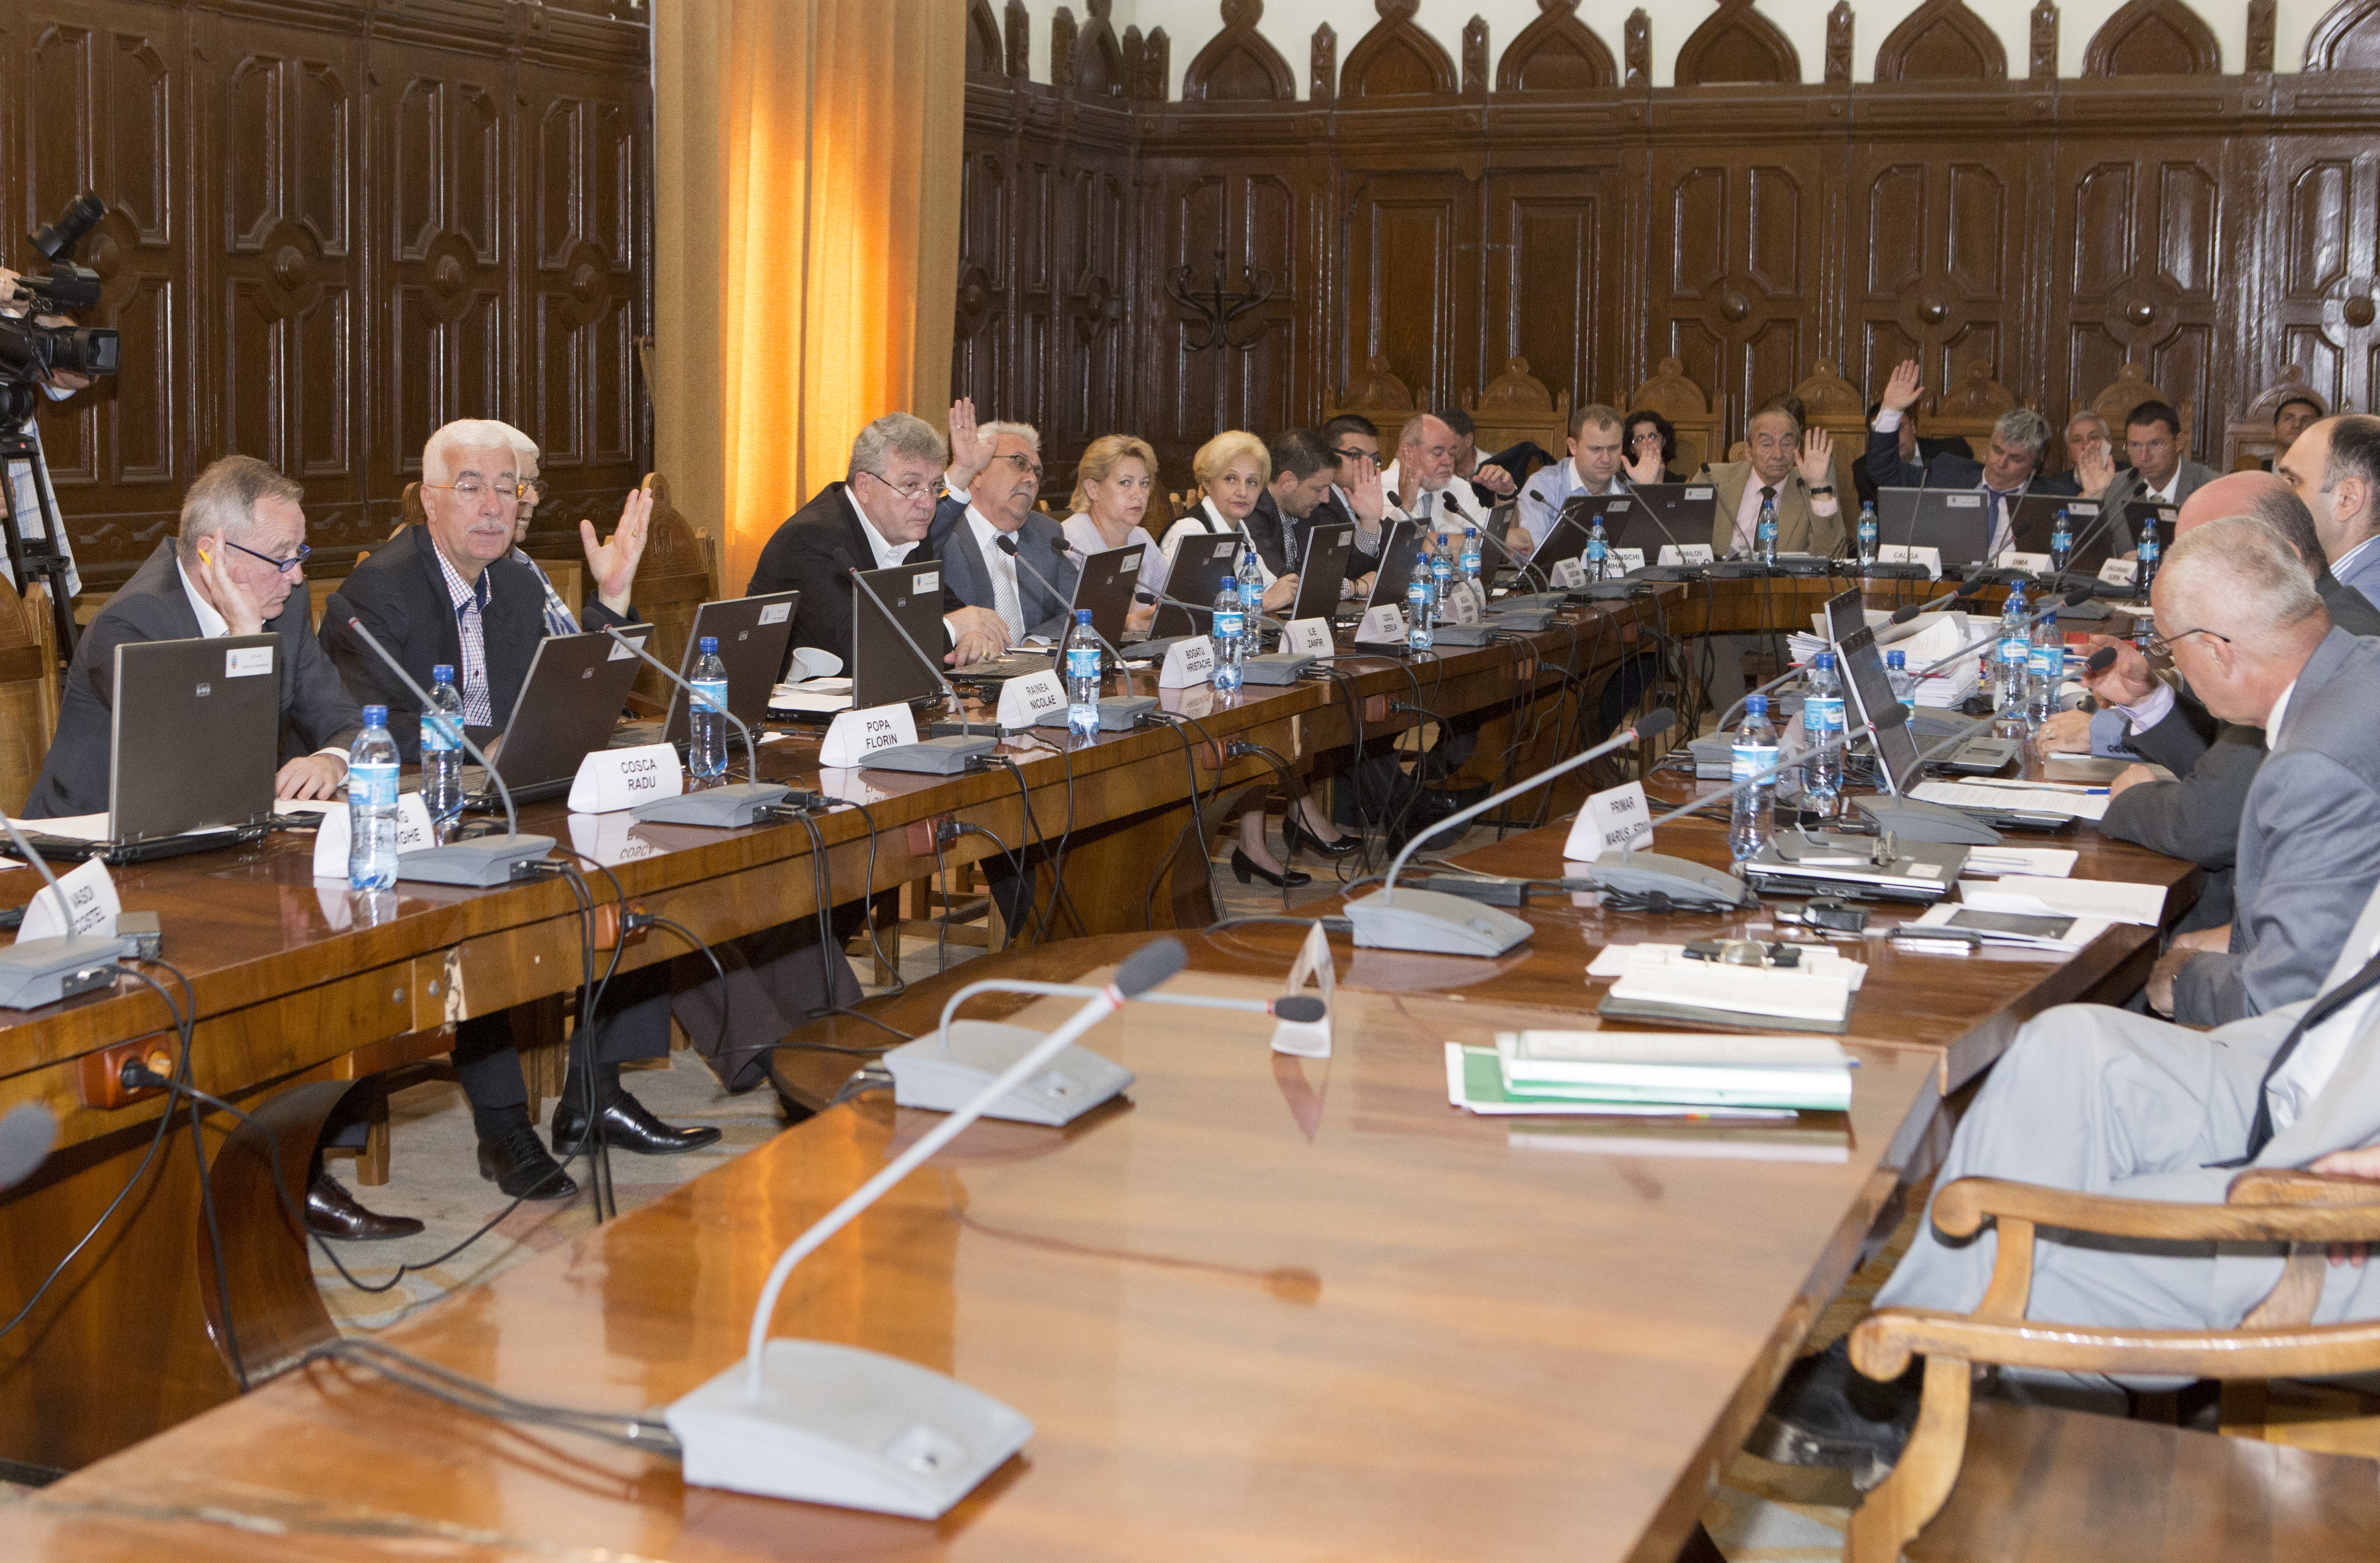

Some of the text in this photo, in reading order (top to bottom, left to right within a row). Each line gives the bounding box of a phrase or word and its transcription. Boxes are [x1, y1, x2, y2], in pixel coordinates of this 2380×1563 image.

[1307, 627, 1317, 636] ILIE
[1307, 638, 1324, 648] ZANFIR
[1185, 646, 1205, 659] BOGATU
[1186, 658, 1212, 673] HRISTACHE
[1026, 682, 1050, 696] RAINEA
[1030, 695, 1057, 710] NICOLAE
[866, 719, 891, 733] POPA
[866, 733, 898, 749] FLORIN
[621, 758, 657, 773] COSCA
[628, 775, 656, 791] RADU
